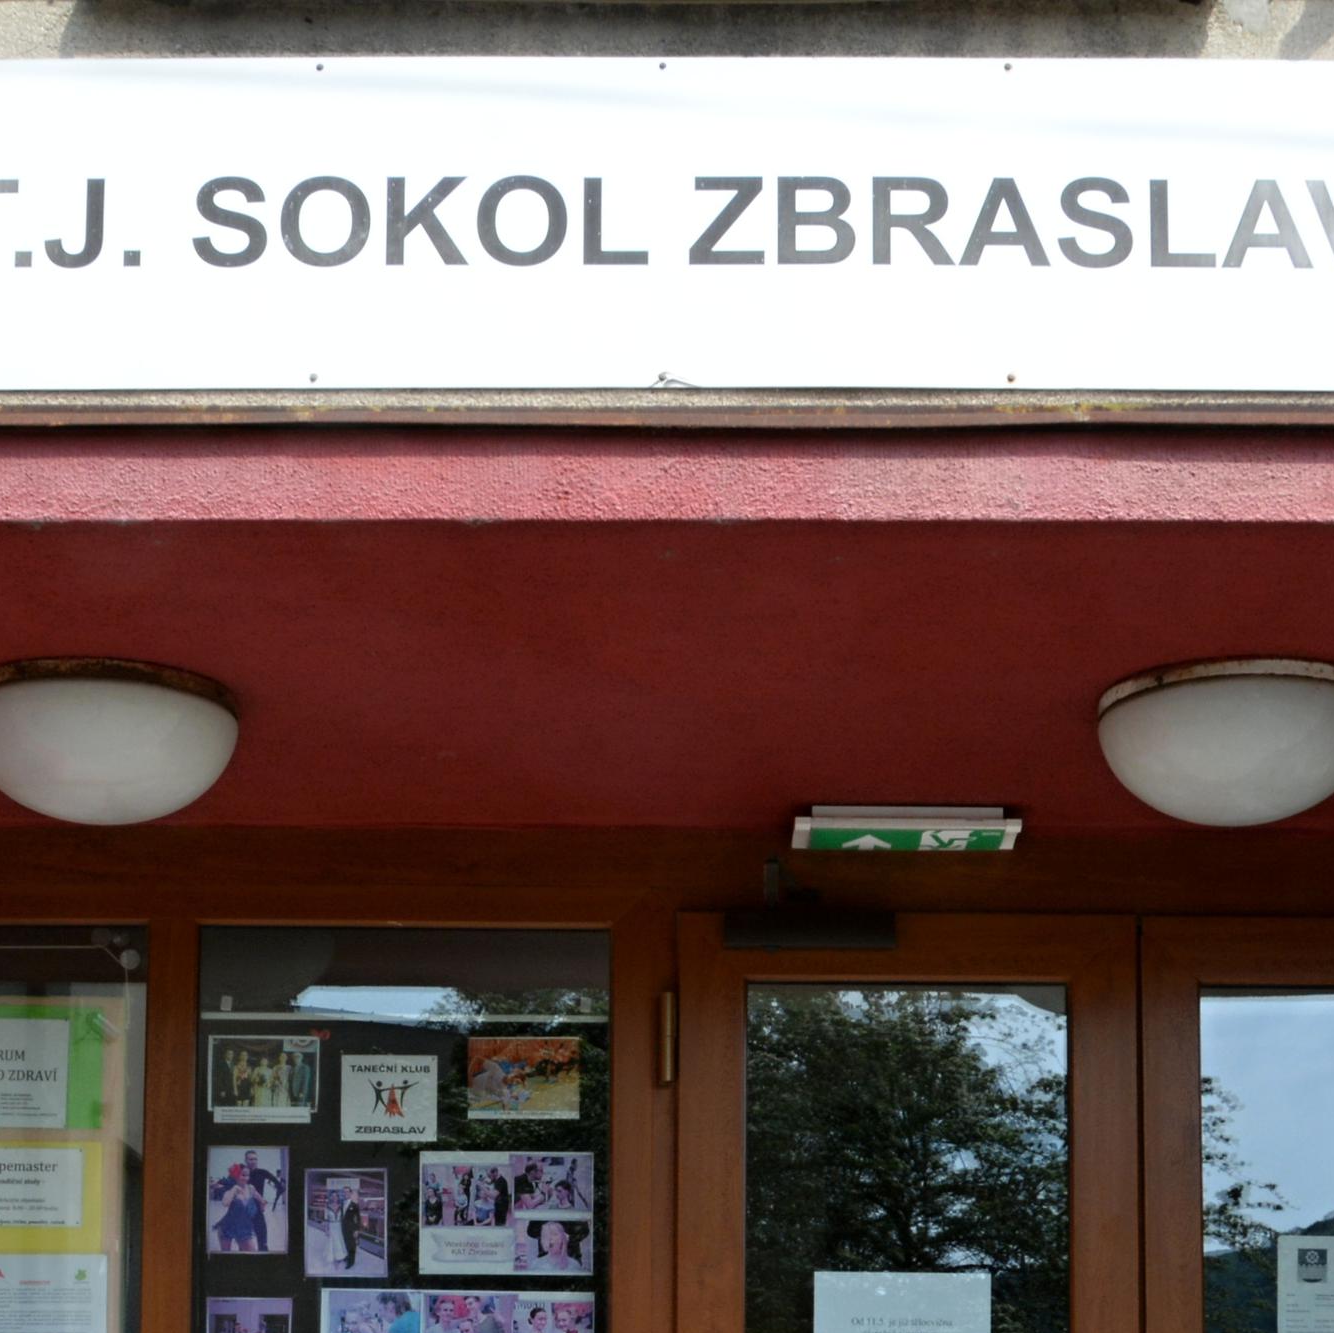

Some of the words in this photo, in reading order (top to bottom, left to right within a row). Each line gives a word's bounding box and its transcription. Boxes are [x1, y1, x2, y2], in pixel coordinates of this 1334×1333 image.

[193, 176, 648, 270] SOKOL
[350, 1062, 397, 1073] TANEČNÍ
[401, 1065, 431, 1073] KLUB
[8, 1067, 58, 1082] ZDRAVÍ
[354, 1125, 427, 1134] ZBRASLAV
[851, 1317, 864, 1326] Od
